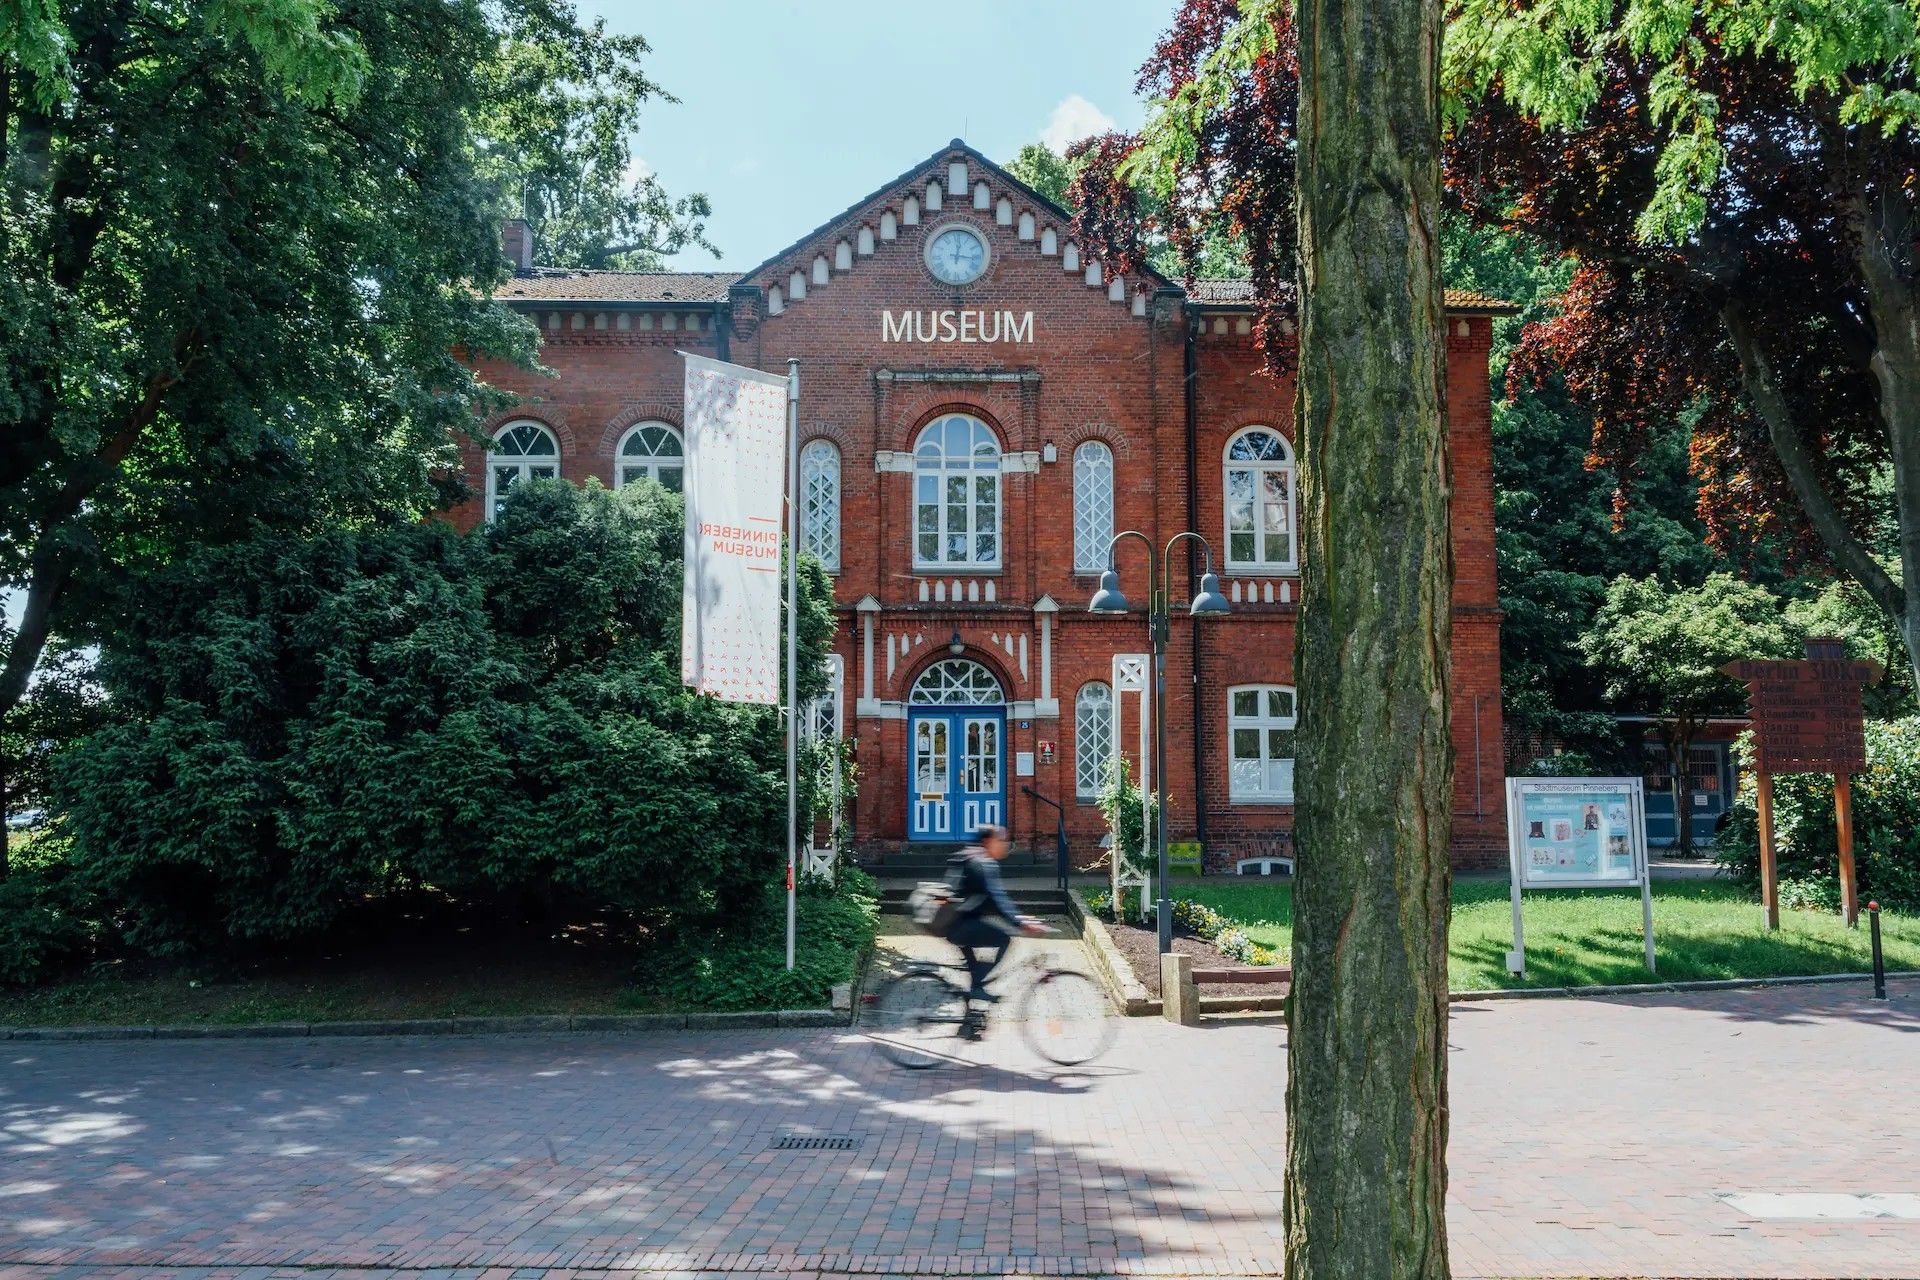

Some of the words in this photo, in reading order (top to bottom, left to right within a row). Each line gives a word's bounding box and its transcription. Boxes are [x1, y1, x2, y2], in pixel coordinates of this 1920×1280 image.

[882, 311, 1034, 343] MUSEUM
[1740, 661, 1799, 681] Berlin
[1534, 784, 1581, 792] Stadtmuseum
[1583, 784, 1618, 794] Pinneberg
